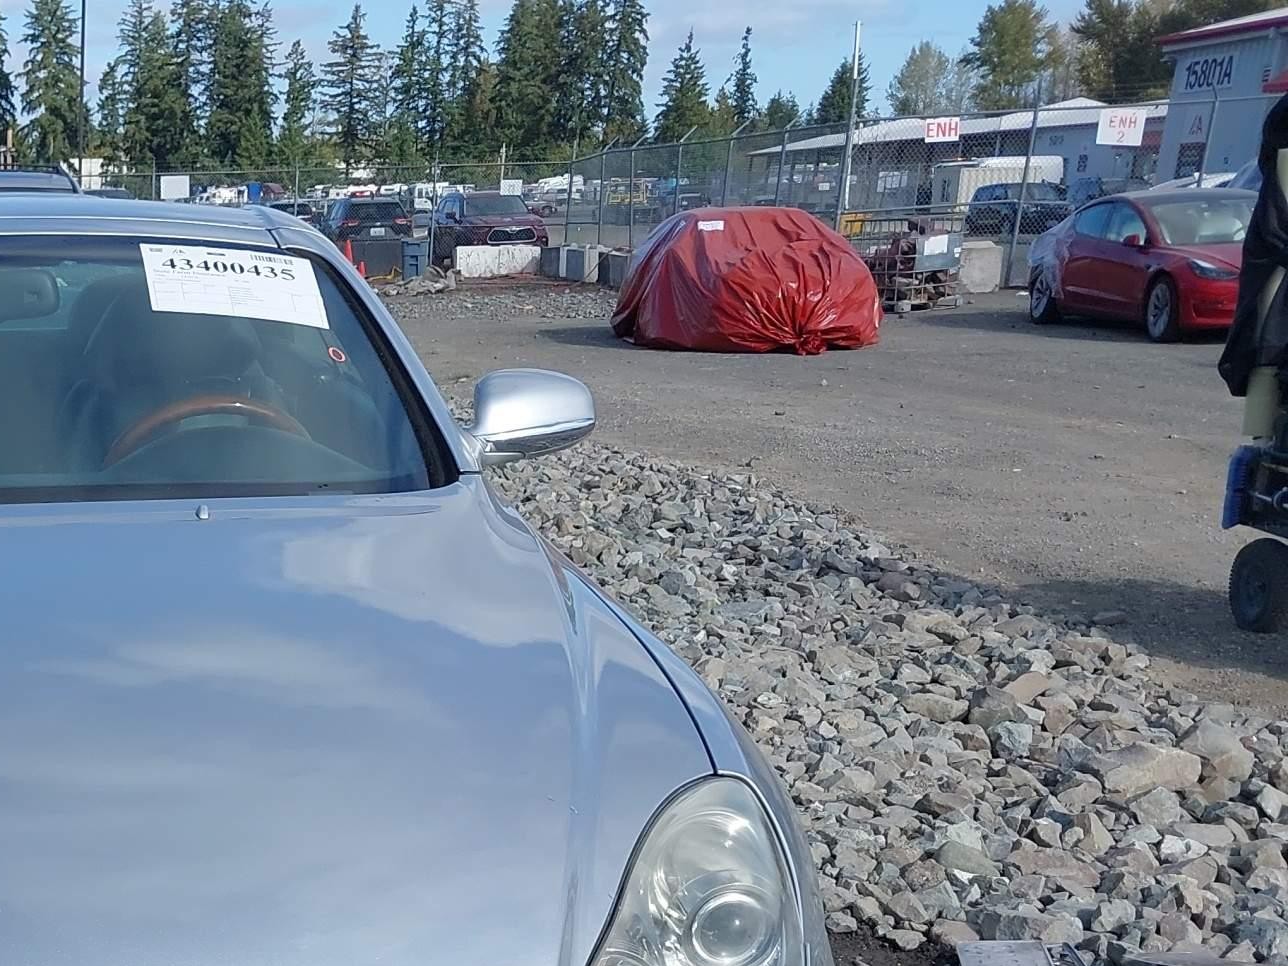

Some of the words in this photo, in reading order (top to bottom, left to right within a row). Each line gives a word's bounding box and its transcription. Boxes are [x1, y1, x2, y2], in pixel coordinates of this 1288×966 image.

[1185, 56, 1233, 90] 15801A
[927, 122, 958, 138] ENH
[1109, 115, 1137, 129] ENH
[1116, 131, 1125, 143] 2
[162, 258, 295, 281] 43400435
